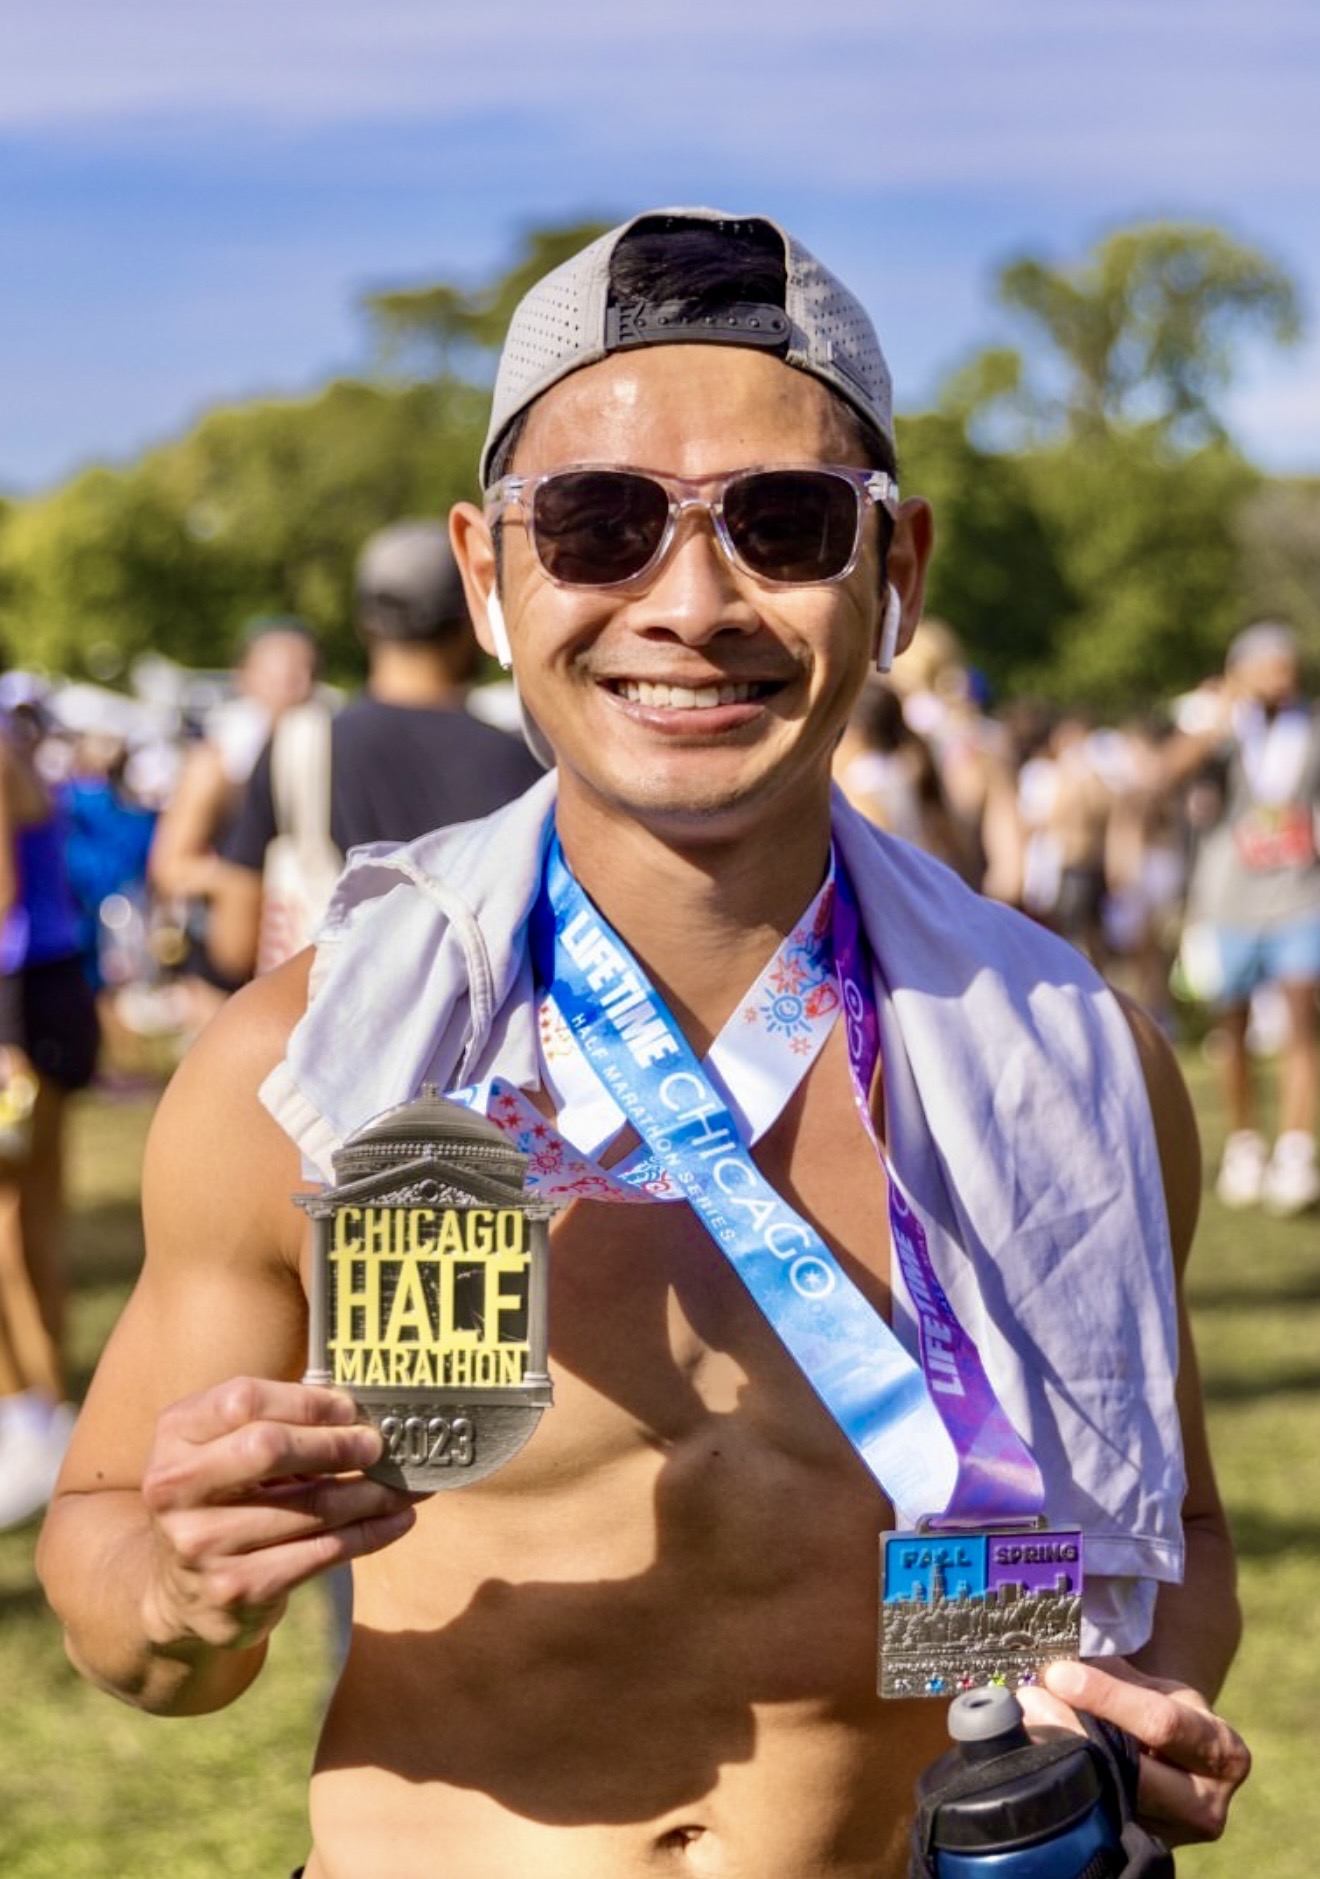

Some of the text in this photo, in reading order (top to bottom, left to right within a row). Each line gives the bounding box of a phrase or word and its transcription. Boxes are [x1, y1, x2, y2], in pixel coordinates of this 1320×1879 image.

[571, 1012, 736, 1242] HALF MARATHON SERIES
[659, 1071, 837, 1299] CHICAGO
[335, 1207, 524, 1254] CHICAGO
[331, 1253, 530, 1349] HALF
[335, 1349, 524, 1387] MARATHON
[380, 1415, 477, 1467] 2023
[903, 1549, 972, 1569] FALL
[994, 1543, 1079, 1566] SPRING
